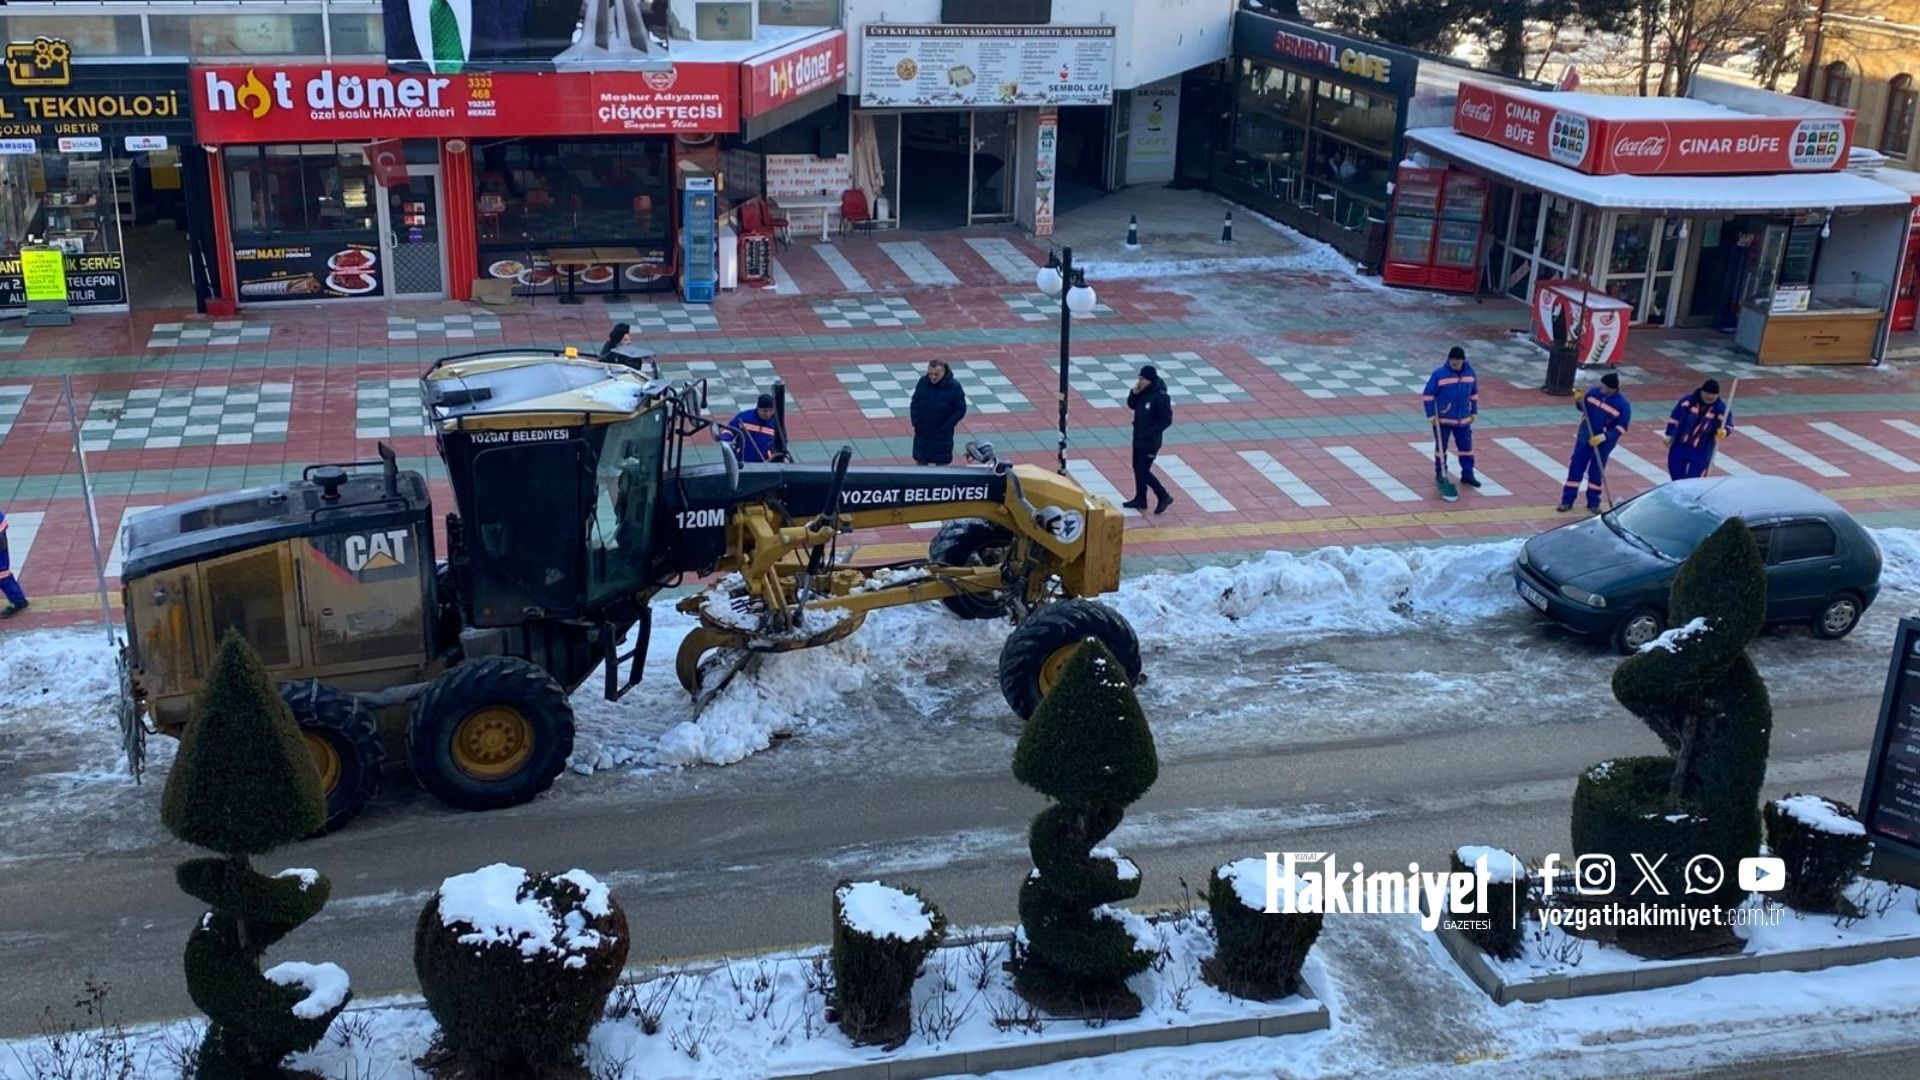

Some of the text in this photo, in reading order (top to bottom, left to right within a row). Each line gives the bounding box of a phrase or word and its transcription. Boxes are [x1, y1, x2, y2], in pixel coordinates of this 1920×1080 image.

[890, 27, 908, 35] KAT
[908, 28, 931, 36] OKEY
[1274, 30, 1392, 83] SEMBOL CAFE
[307, 69, 450, 109] döner
[600, 93, 720, 102] Meşhur Adıyaman
[1048, 84, 1109, 92] SEMBOL CAFE
[23, 89, 178, 118] TEKNOLOJİ
[310, 106, 455, 120] özel soslu HATAY döneri
[598, 103, 723, 123] ÇİĞKÖFTECİSİ
[1505, 102, 1541, 125] ÇINAR
[1505, 123, 1536, 145] BÜFE
[1554, 121, 1585, 141] DAHA
[1797, 132, 1840, 144] DAHA
[1552, 134, 1583, 154] DAHA
[1680, 134, 1780, 156] ÇINAR BÜFE
[1794, 144, 1837, 156] DAHA
[79, 254, 122, 270] SERVİS
[66, 275, 116, 288] TELEFON
[470, 429, 570, 444] YOZGAT BELEDİYESİ
[840, 483, 990, 504] YOZGAT BELEDİYESİ
[676, 508, 726, 529] 120M
[345, 529, 408, 571] CAT
